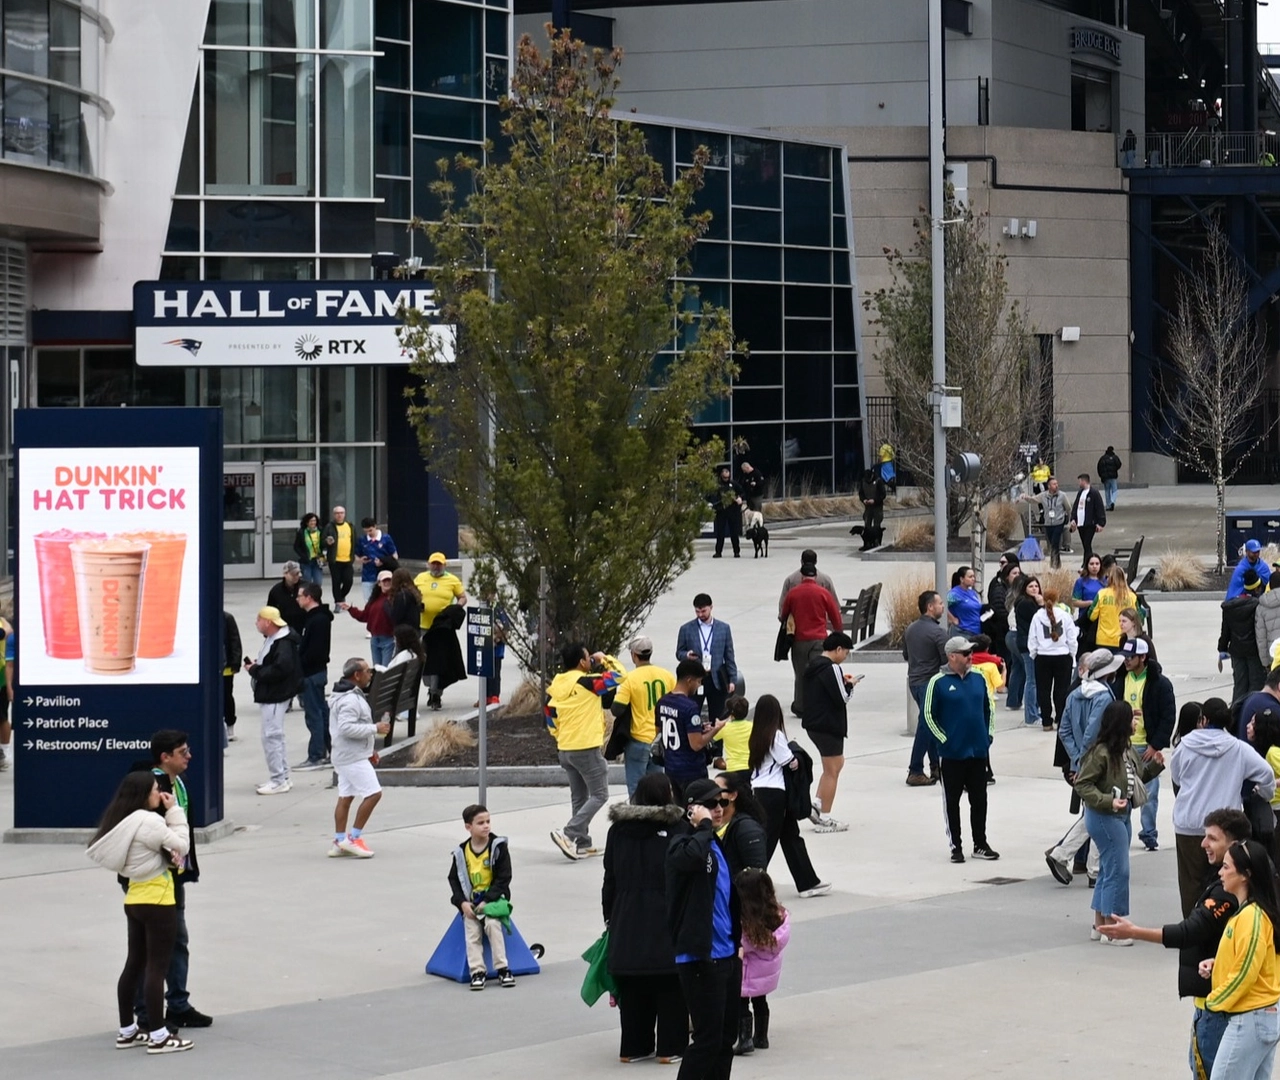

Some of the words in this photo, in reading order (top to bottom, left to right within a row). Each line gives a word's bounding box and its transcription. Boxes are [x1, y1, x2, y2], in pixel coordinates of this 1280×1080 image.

[1074, 30, 1103, 49] BRIDGE
[1104, 37, 1121, 59] BAR
[154, 289, 285, 318] HALL
[287, 297, 312, 311] OF
[328, 339, 366, 354] RTX
[55, 465, 164, 486] DUNKIN'
[223, 474, 254, 486] ENTER
[273, 473, 304, 485] ENTER
[33, 489, 91, 511] HAT
[99, 488, 186, 510] TRICK
[103, 579, 120, 657] DUNKIN'
[36, 696, 81, 707] Pavilion
[644, 679, 666, 711] 10
[36, 717, 75, 728] Patriot
[78, 717, 109, 728] Place
[660, 716, 680, 751] 19
[36, 738, 103, 751] Restrooms/
[1214, 902, 1230, 919] vivo
